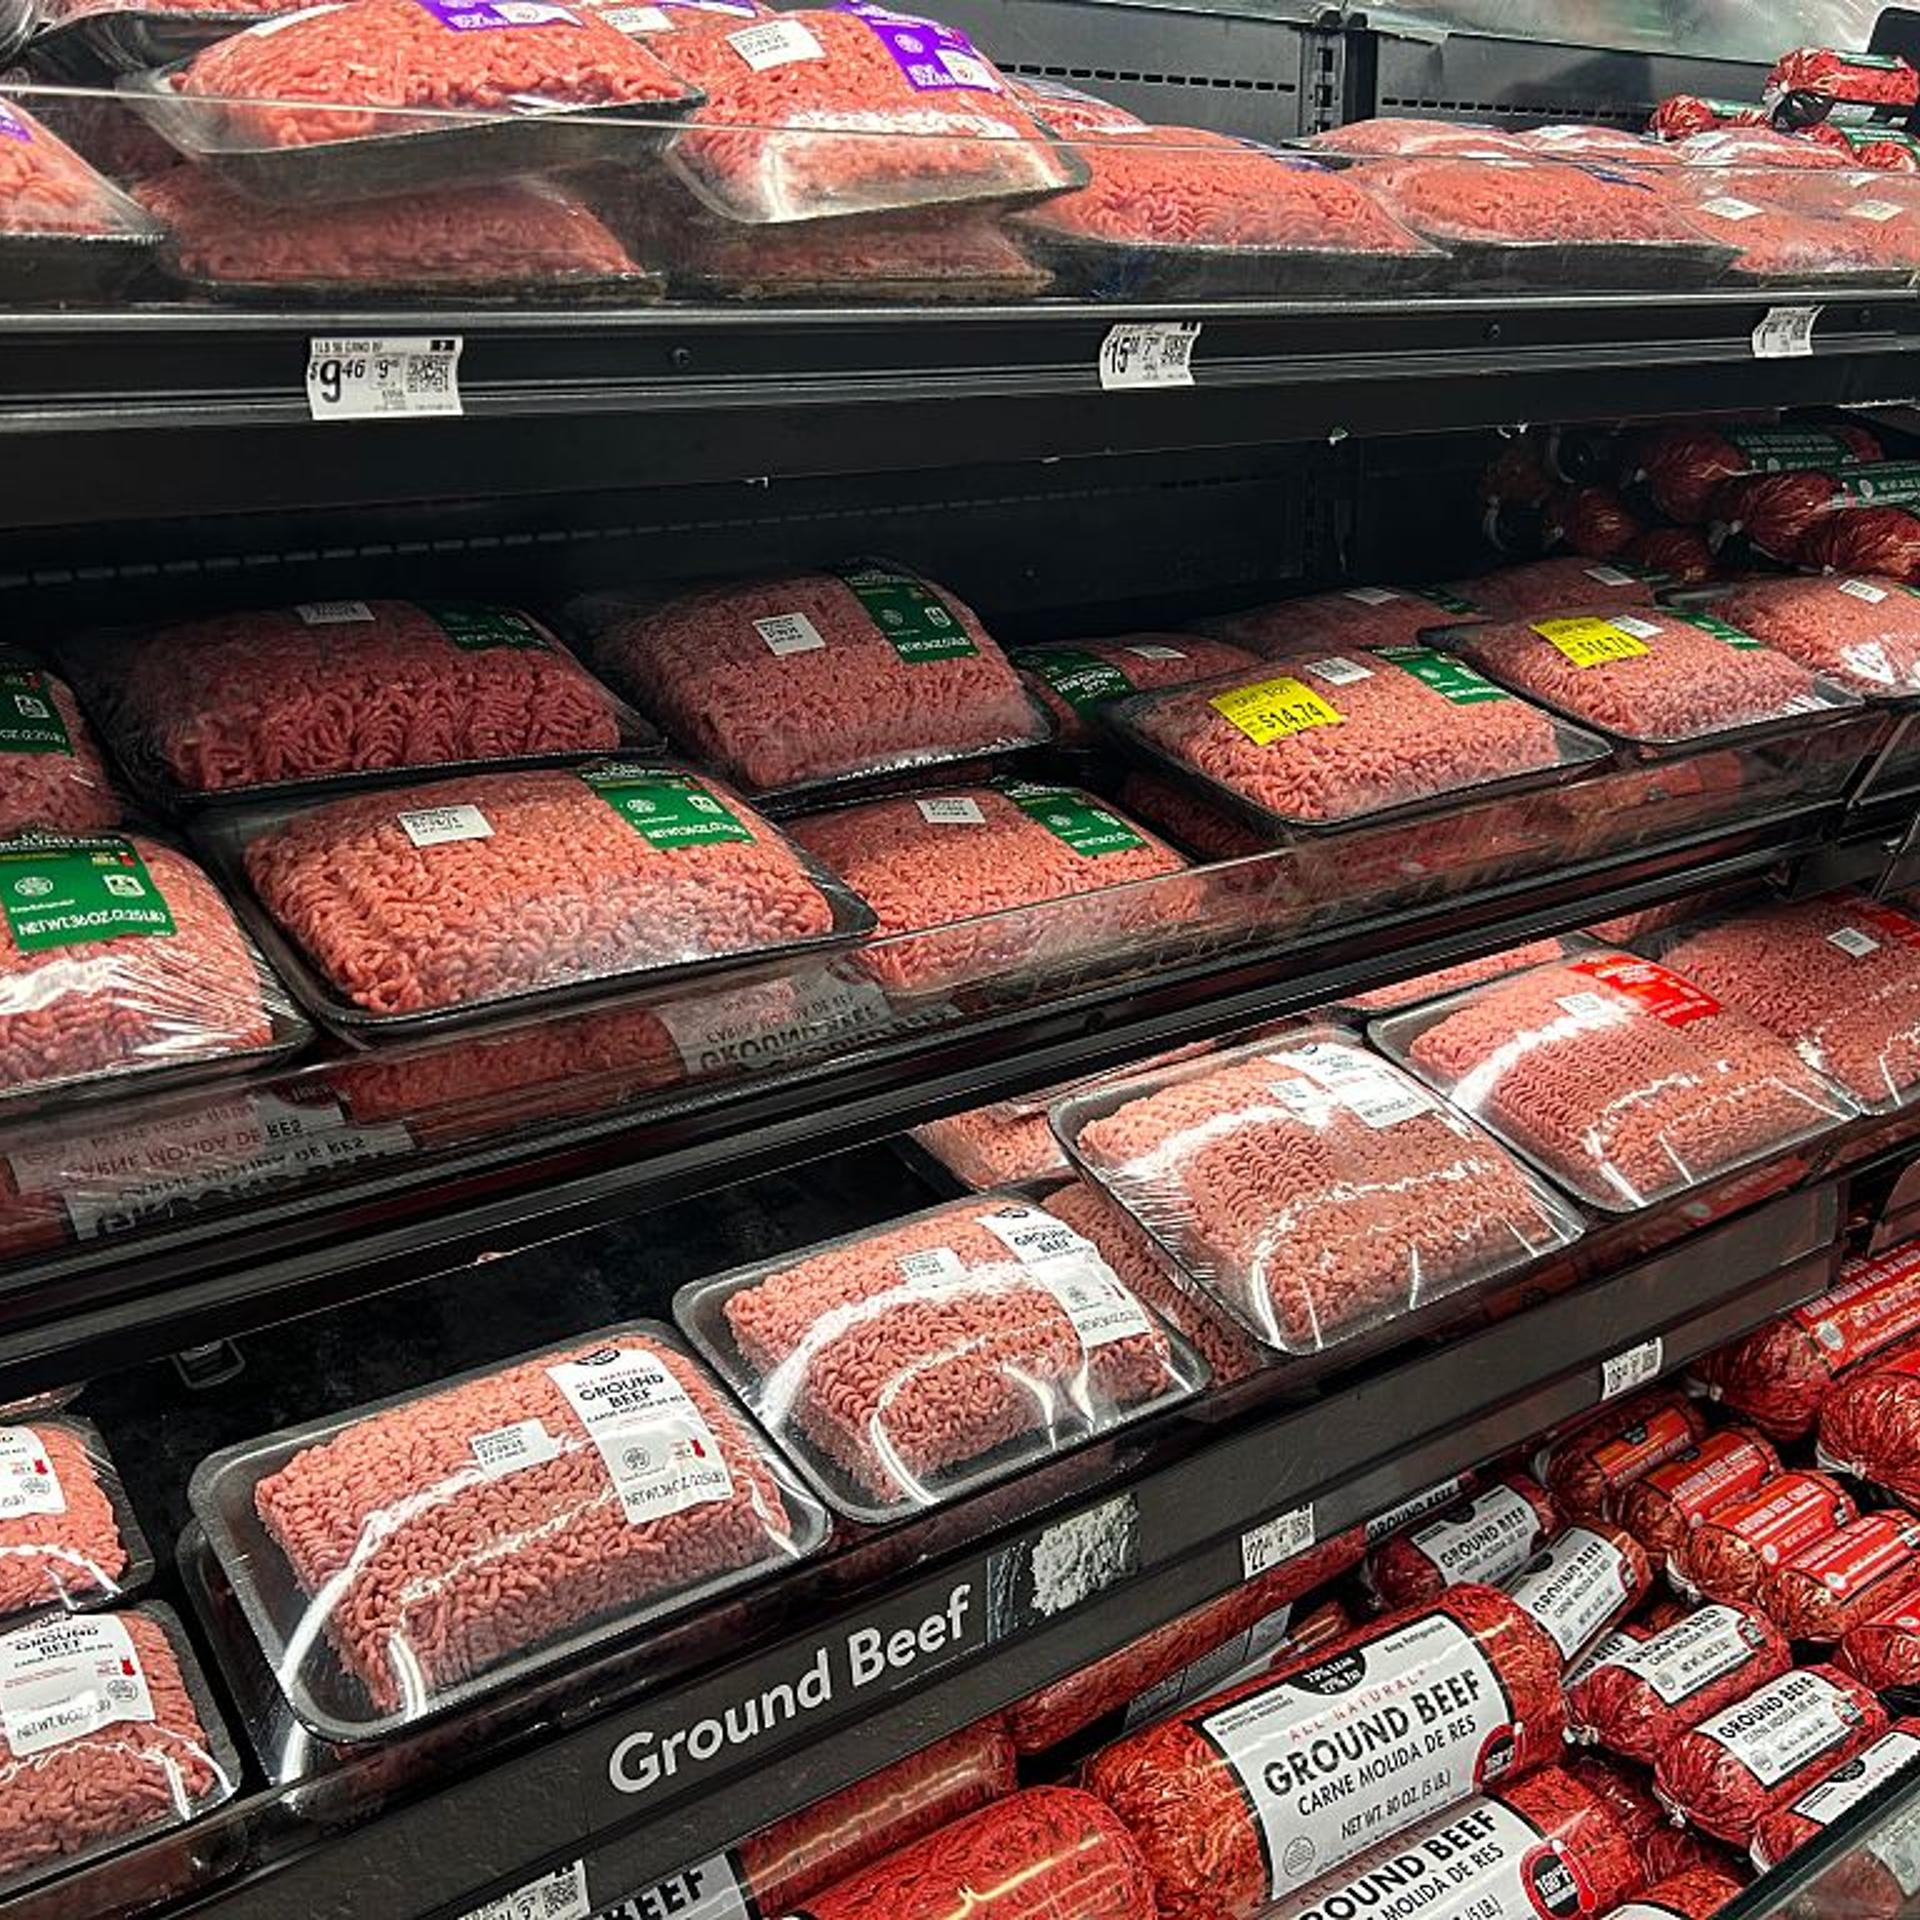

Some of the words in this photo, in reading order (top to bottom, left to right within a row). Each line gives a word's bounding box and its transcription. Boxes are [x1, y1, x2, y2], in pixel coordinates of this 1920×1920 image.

[1258, 702, 1327, 729] $14.74
[579, 1373, 665, 1403] GROUND
[608, 1389, 652, 1408] BEEF
[1440, 1525, 1499, 1568] GROUND
[1498, 1507, 1527, 1533] BEEF
[609, 1647, 832, 1793] Ground
[847, 1583, 971, 1688] Beef
[1718, 1694, 1784, 1739] GROUND
[1778, 1676, 1817, 1702] BEEF
[1264, 1705, 1411, 1796] GROUND
[1409, 1668, 1481, 1726] BEEF
[1290, 1719, 1327, 1742] ALL
[1298, 1774, 1357, 1817] CARNE
[1358, 1741, 1424, 1787] MOLIDA
[1424, 1728, 1447, 1754] DE
[1447, 1713, 1477, 1744] RES
[1341, 1814, 1364, 1841] NET
[1363, 1803, 1386, 1830] WT.
[1423, 1809, 1497, 1861] BEEF
[1380, 1876, 1450, 1920] MOLIDA
[1446, 1860, 1474, 1884] DE
[1470, 1841, 1505, 1870] RES
